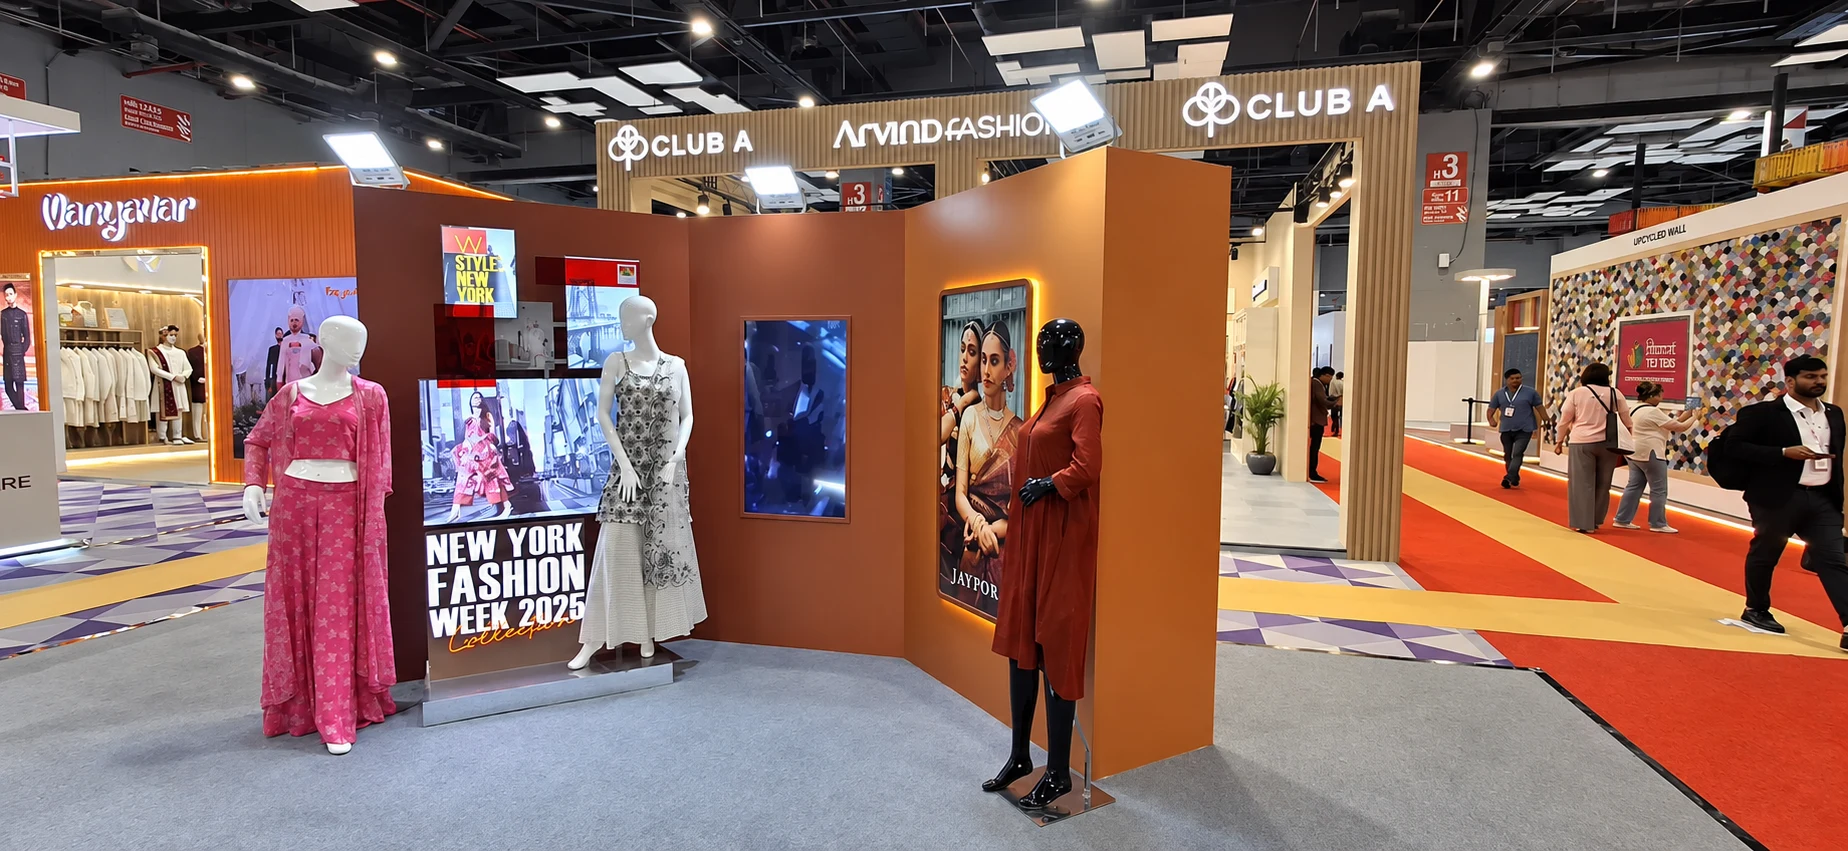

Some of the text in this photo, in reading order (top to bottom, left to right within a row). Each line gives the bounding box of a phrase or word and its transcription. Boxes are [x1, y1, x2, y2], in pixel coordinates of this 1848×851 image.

[1246, 84, 1395, 121] CLUB A
[651, 129, 754, 157] CLUB A
[1633, 224, 1687, 246] UPCYCLED WALL
[456, 271, 489, 287] NEW
[456, 287, 495, 304] YORK
[425, 522, 583, 566] NEW YORK
[427, 553, 586, 607] FASHION
[428, 591, 586, 638] WEEK 2025
